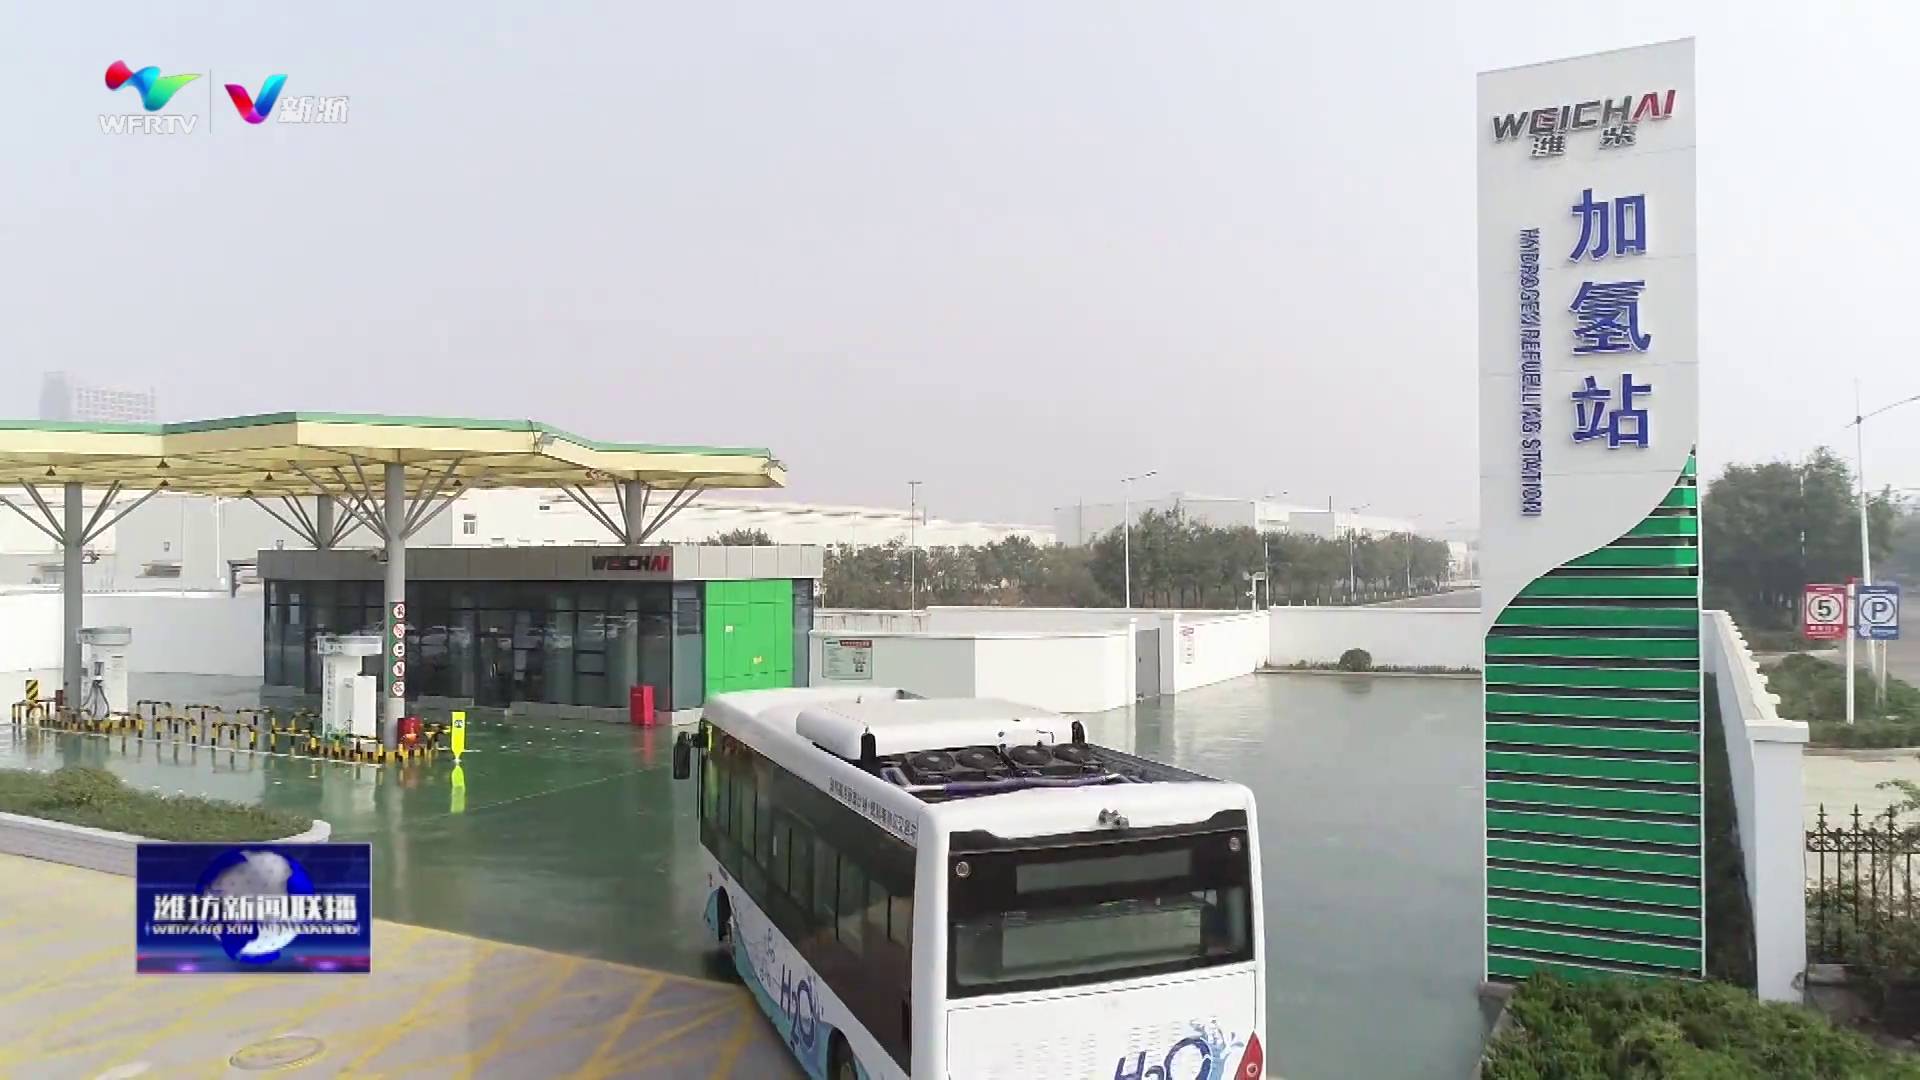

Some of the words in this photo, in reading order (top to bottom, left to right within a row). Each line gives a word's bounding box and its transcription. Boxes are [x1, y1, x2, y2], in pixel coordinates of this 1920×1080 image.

[1493, 90, 1676, 140] WEICHAI
[1519, 228, 1541, 327] HYDROGEN
[1570, 188, 1652, 448] 加氢站
[1520, 329, 1543, 433] REFUELLING
[1521, 438, 1543, 517] STATION
[1817, 599, 1832, 617] 5
[1871, 601, 1888, 620] P
